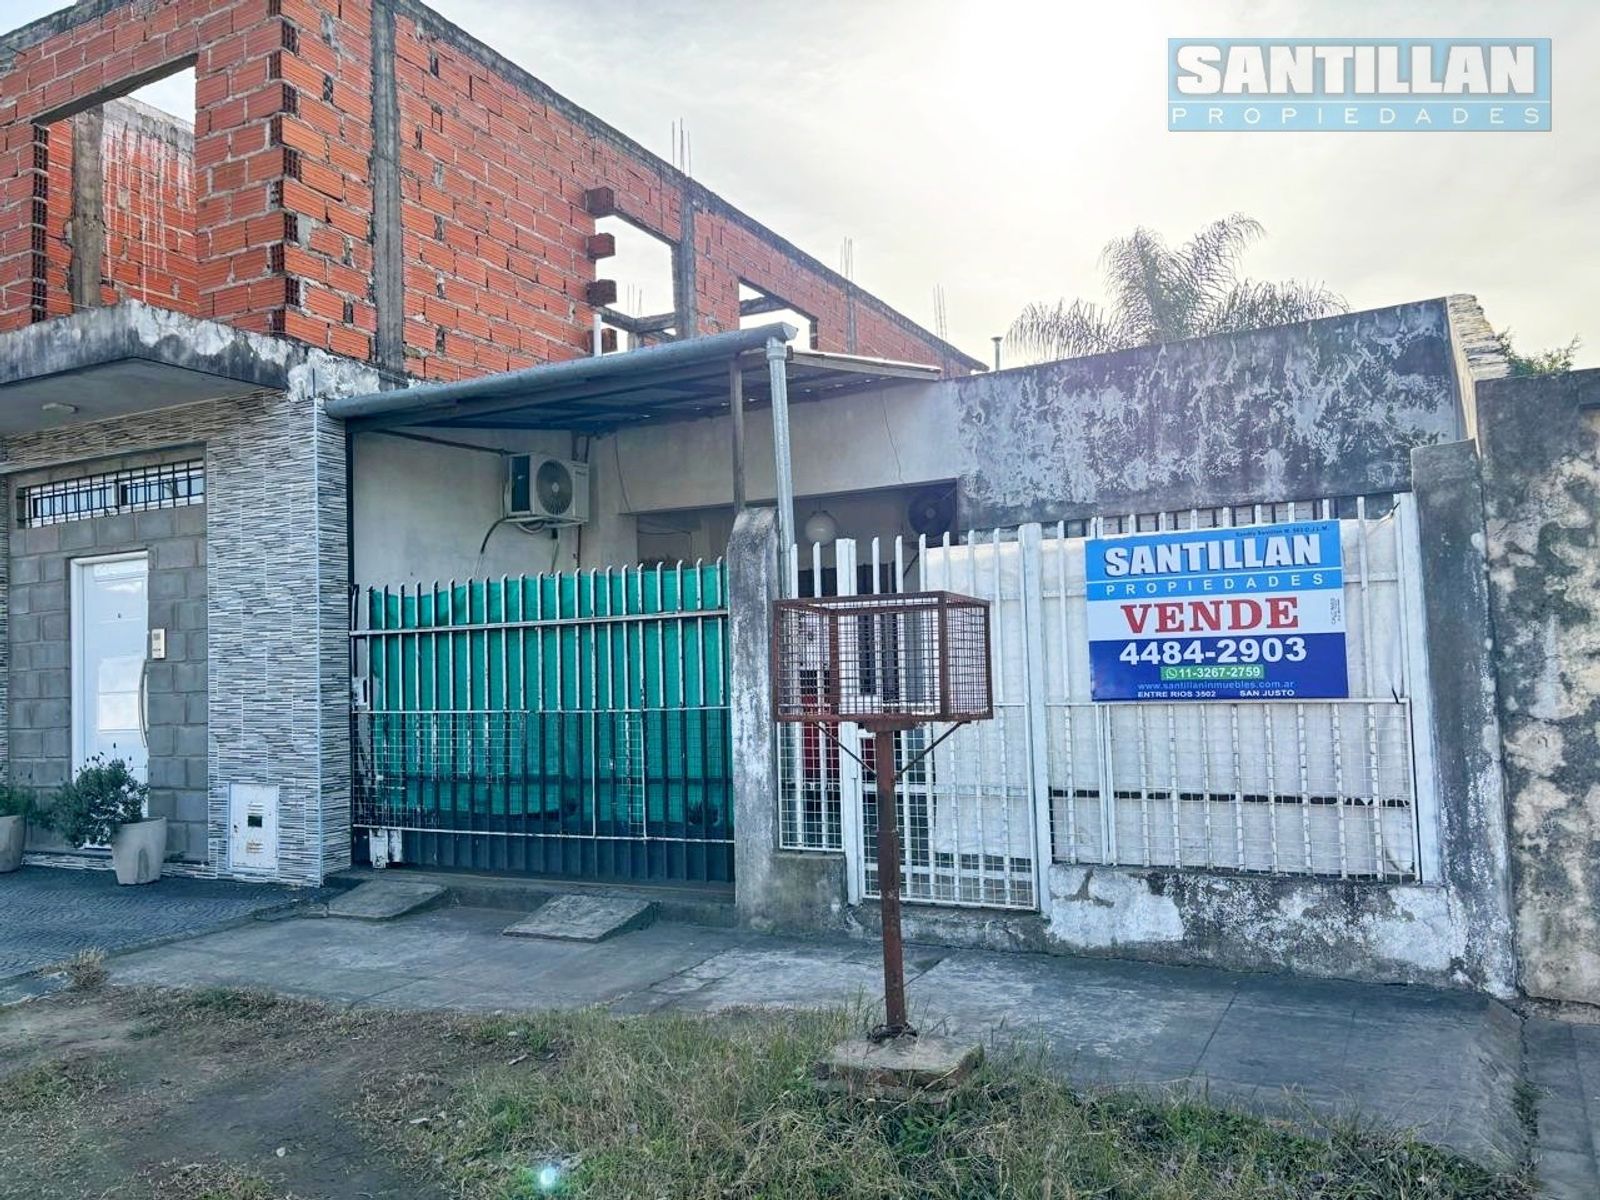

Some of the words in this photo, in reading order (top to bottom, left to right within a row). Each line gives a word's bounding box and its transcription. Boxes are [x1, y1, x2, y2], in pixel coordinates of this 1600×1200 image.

[1104, 533, 1321, 577] SANTILLAN
[1106, 573, 1324, 596] PROPIEDADES
[1121, 597, 1299, 634] VENDE
[1119, 637, 1307, 665] 4484-2903
[1178, 666, 1261, 679] 11-3267-2759
[1170, 690, 1193, 698] RIOS
[1239, 689, 1260, 697] SAN
[1262, 688, 1295, 697] JUSTO
